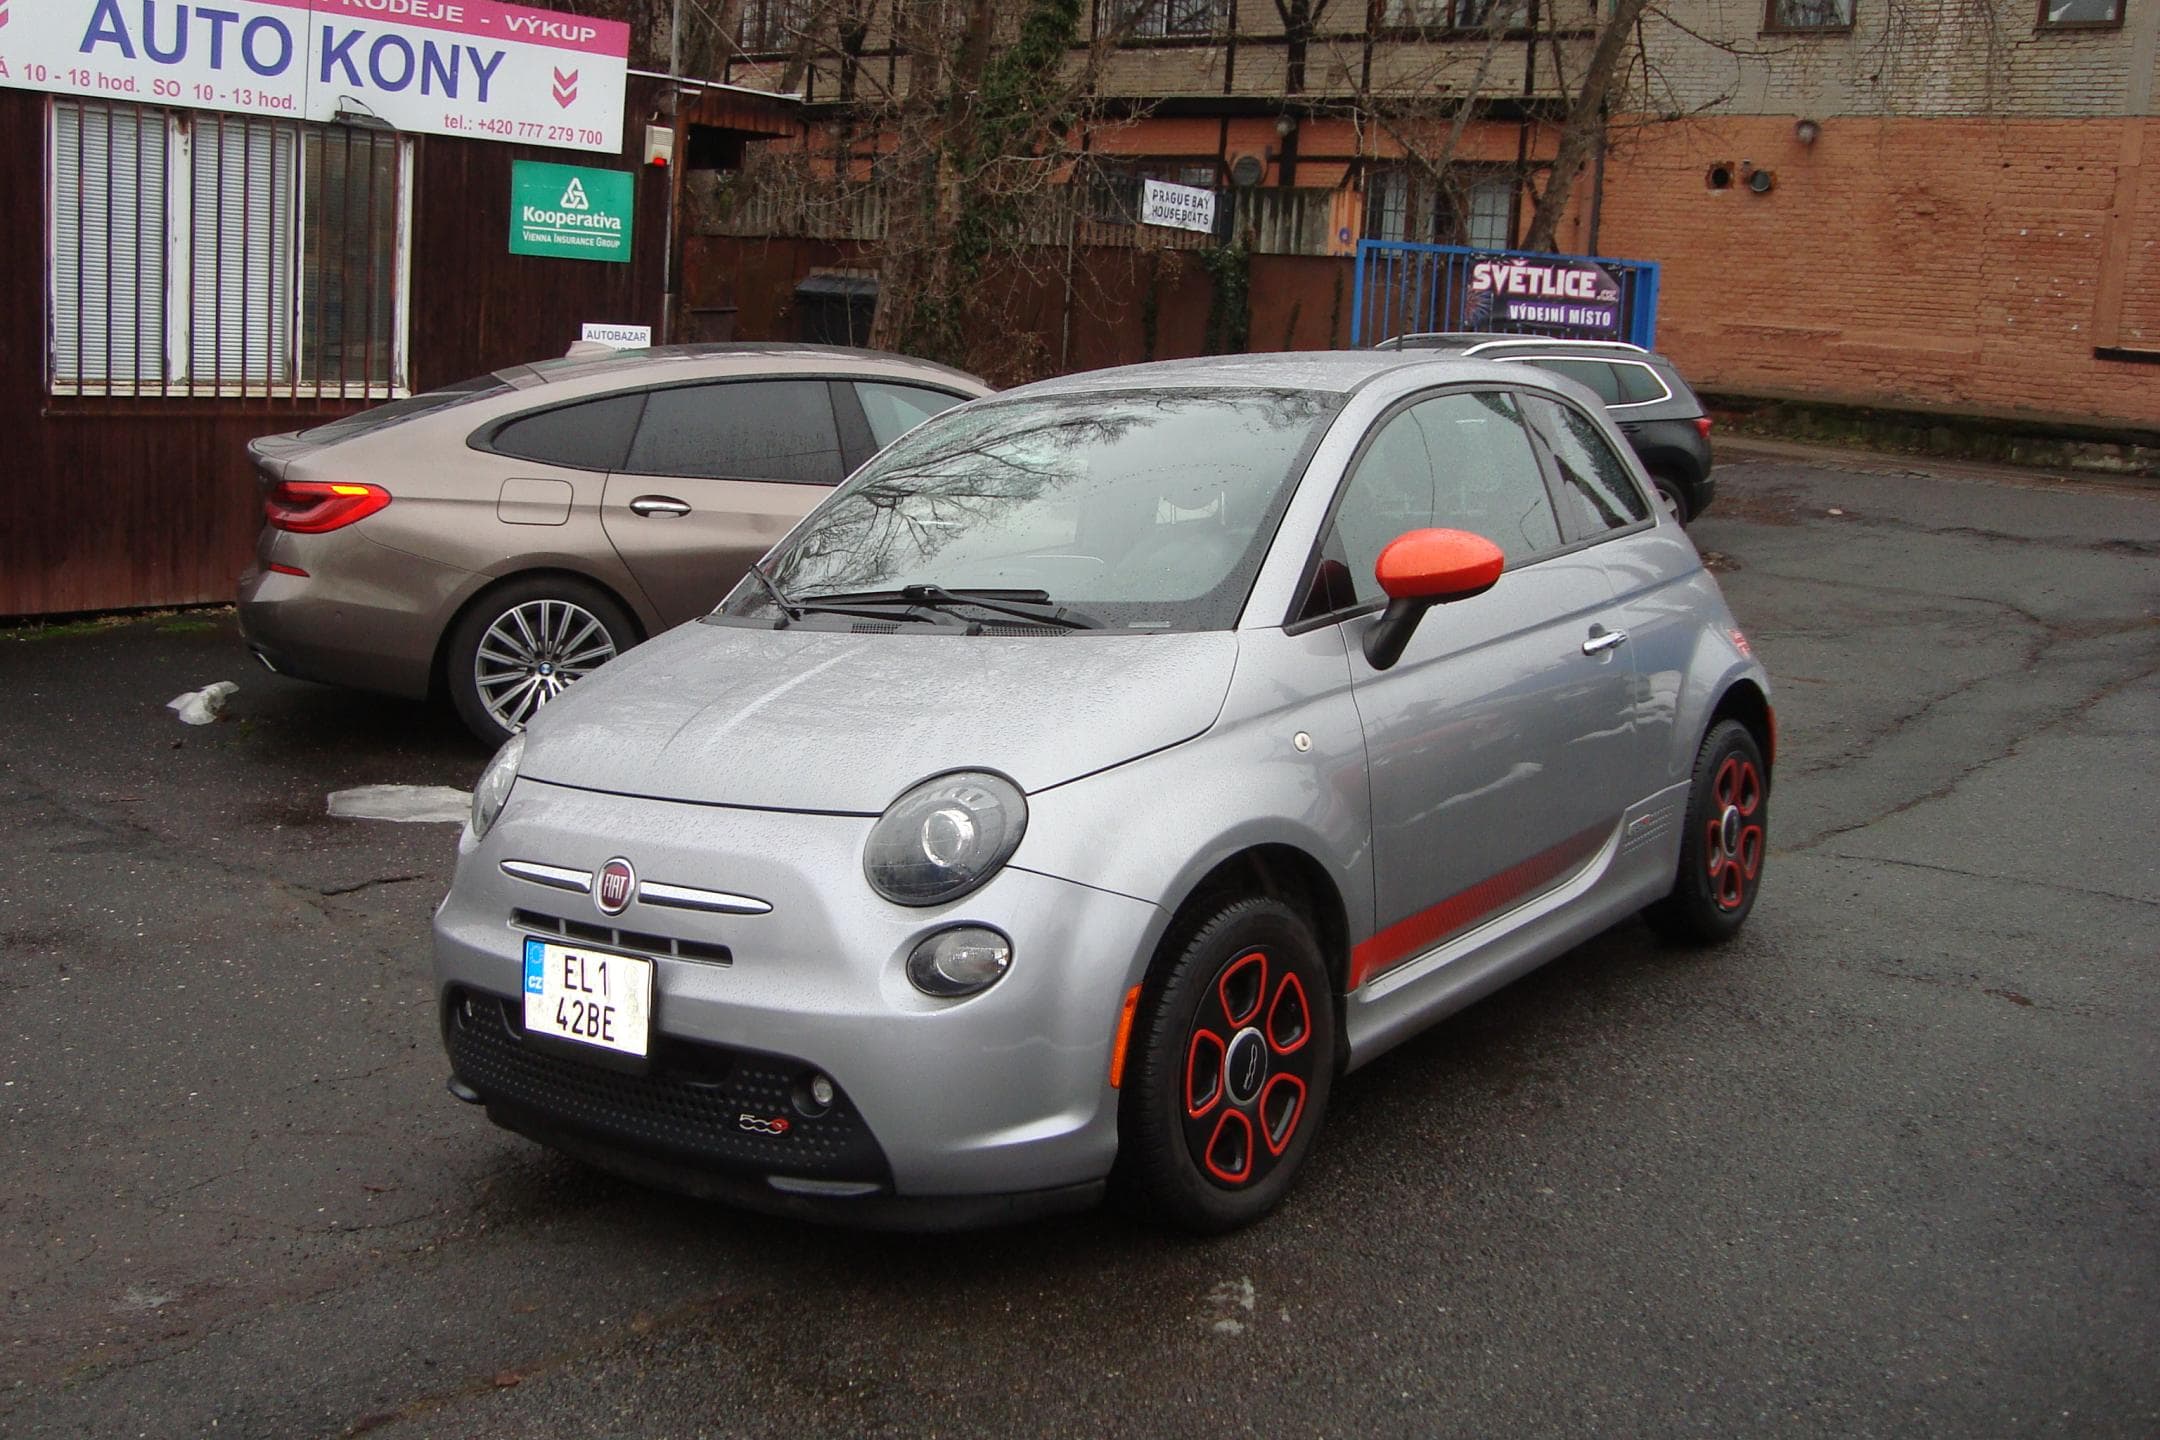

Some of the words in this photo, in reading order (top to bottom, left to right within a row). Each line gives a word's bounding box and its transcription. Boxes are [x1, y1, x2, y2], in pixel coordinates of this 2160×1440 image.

[505, 15, 597, 43] VÝKUP
[79, 0, 293, 77] AUTO
[320, 25, 507, 103] KONY
[24, 63, 46, 82] 10
[68, 68, 90, 88] 18
[98, 72, 140, 93] hod.
[152, 78, 181, 97] SO
[193, 84, 213, 101] 10
[232, 88, 252, 105] 13
[258, 91, 297, 111] hod.
[444, 114, 473, 131] tel.:
[478, 119, 512, 135] +420
[518, 122, 544, 138] 777
[548, 125, 574, 142] 279
[578, 128, 603, 145] 700
[1152, 188, 1190, 207] PRAGUE
[1191, 195, 1210, 210] BAY
[523, 205, 622, 230] Kooperativa
[1472, 259, 1597, 299] SVĚTLICE
[1509, 303, 1565, 322] VÝDEJNÍ
[1569, 306, 1611, 326] MÍSTO
[586, 330, 647, 342] AUTOBAZAR
[603, 873, 628, 899] FIAT
[528, 975, 543, 989] CZ
[556, 997, 615, 1042] 42BE
